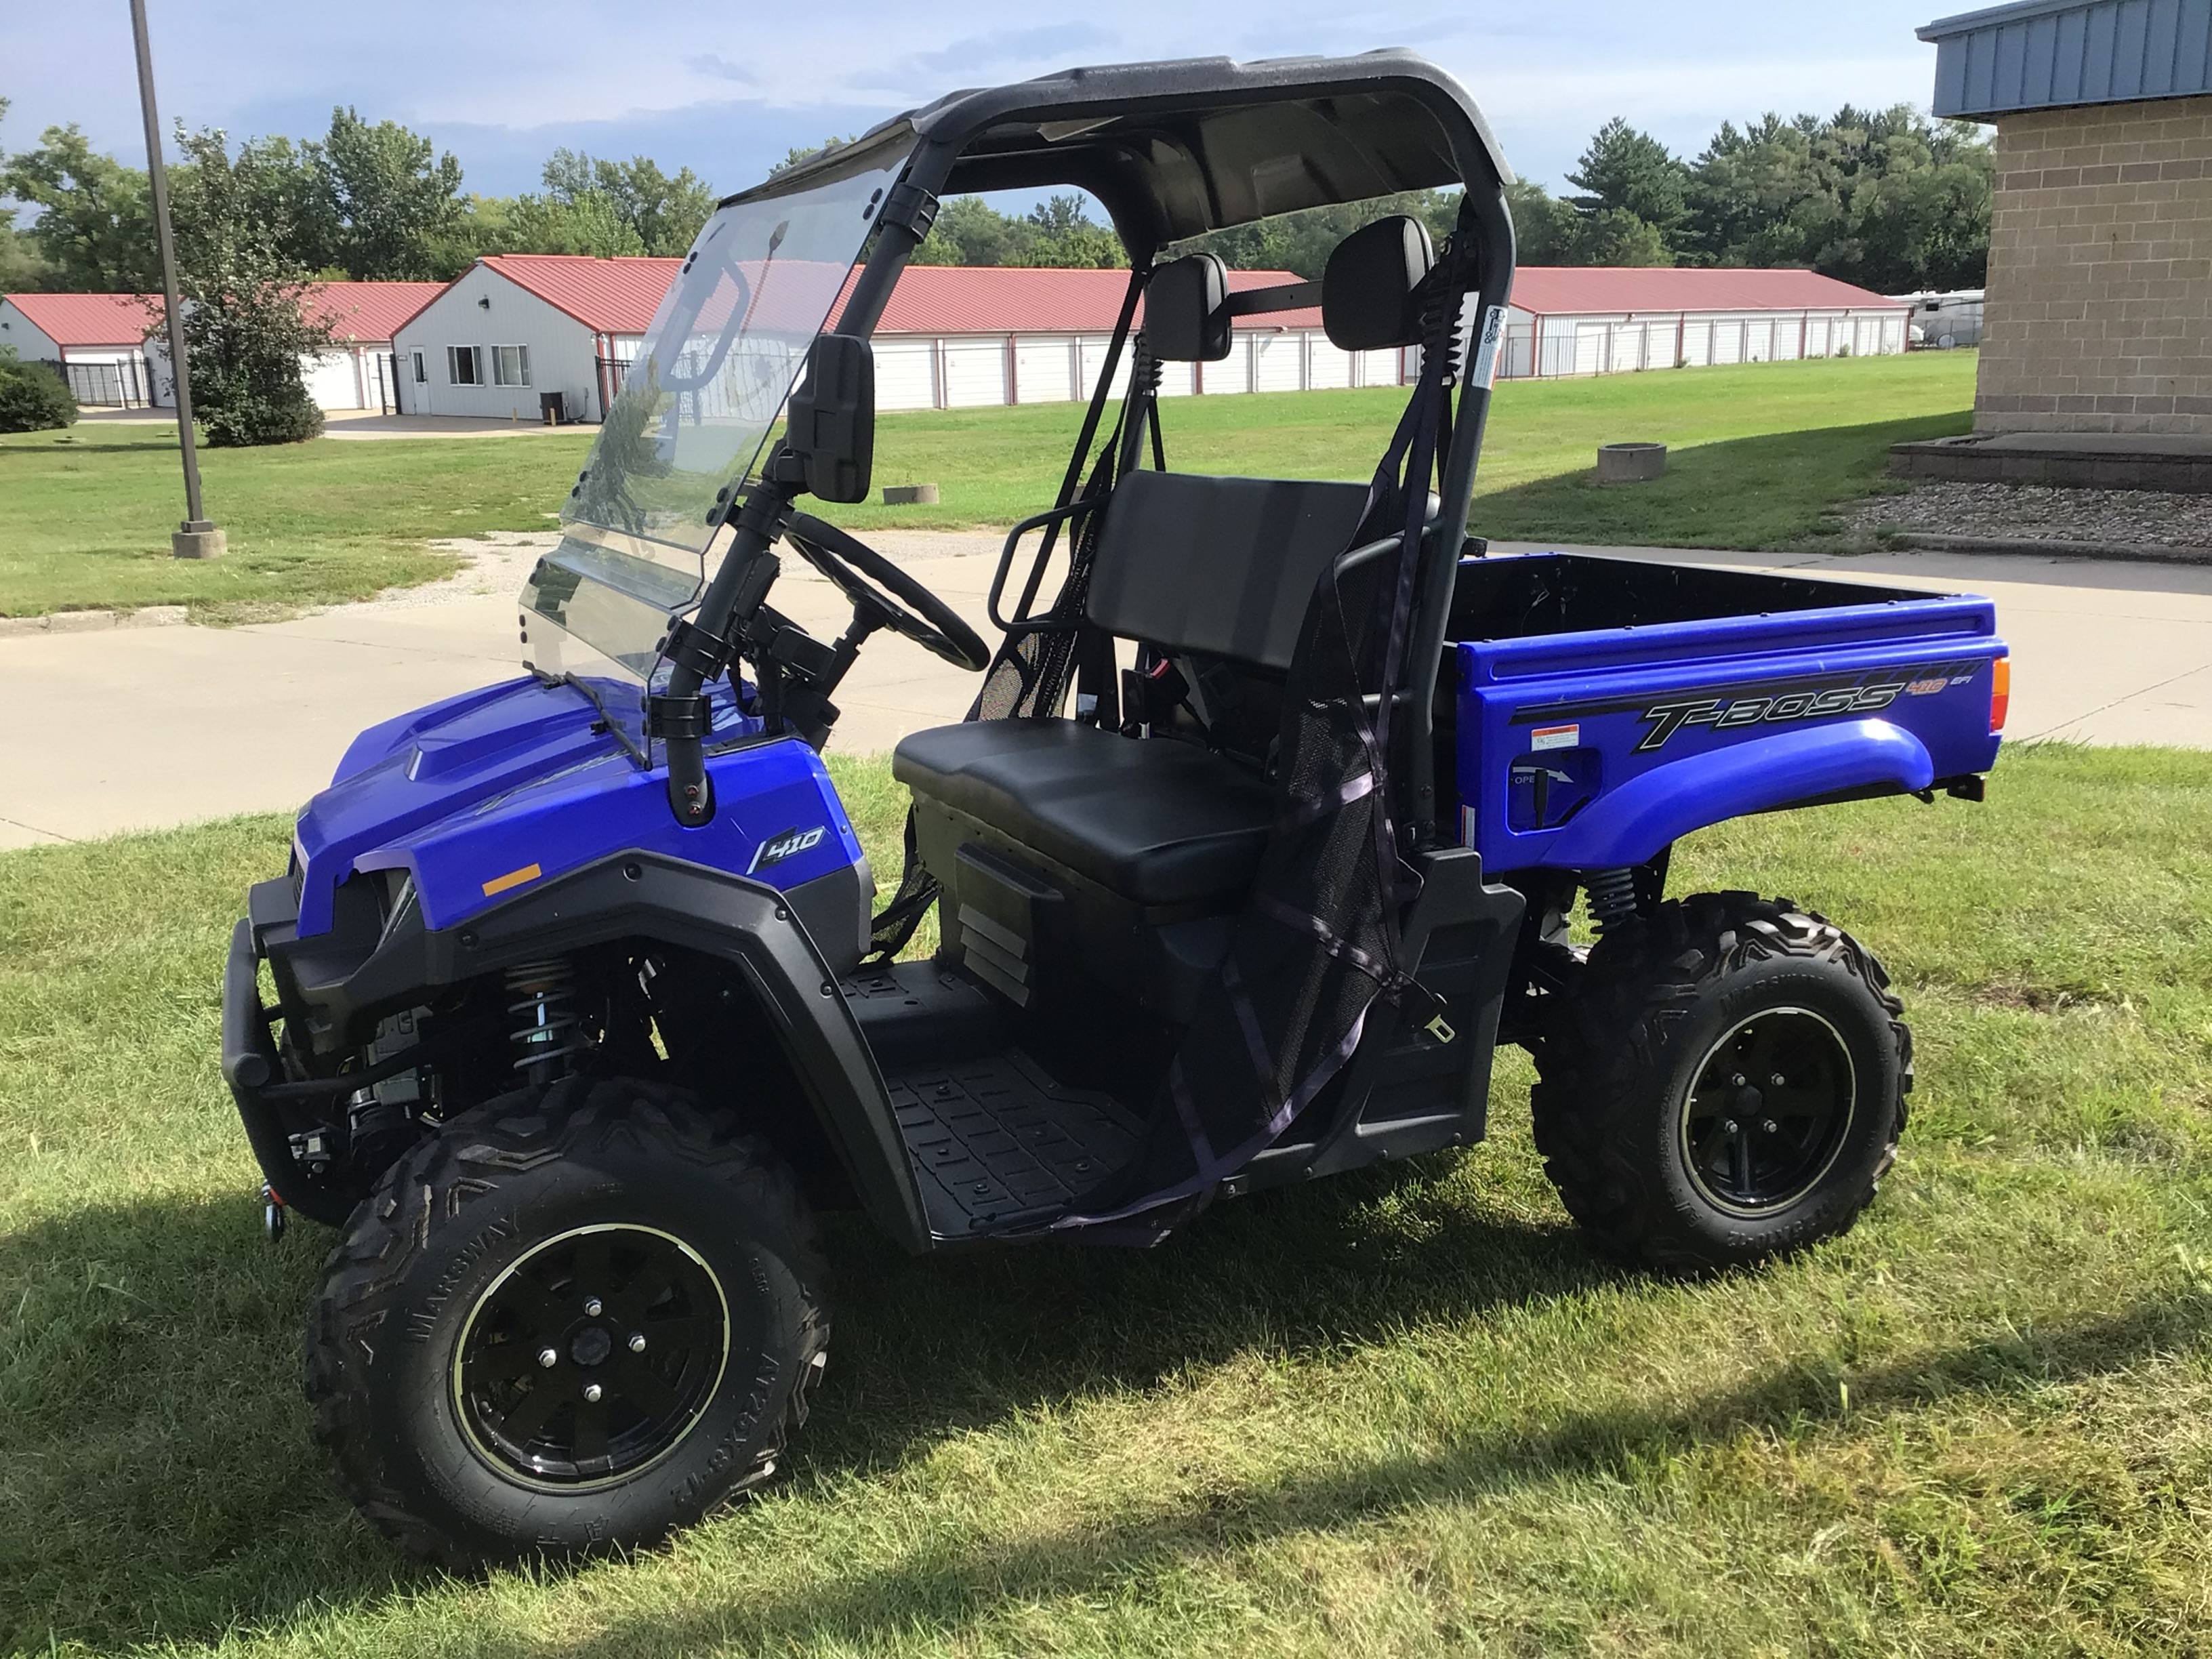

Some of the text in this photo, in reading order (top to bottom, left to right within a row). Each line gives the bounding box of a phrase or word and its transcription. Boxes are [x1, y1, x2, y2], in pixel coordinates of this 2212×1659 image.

[1636, 676, 1973, 751] T-BOSS 410 EFI
[1515, 775, 1535, 785] OPE
[764, 827, 825, 861] 410
[406, 1206, 520, 1340] MARSWAY
